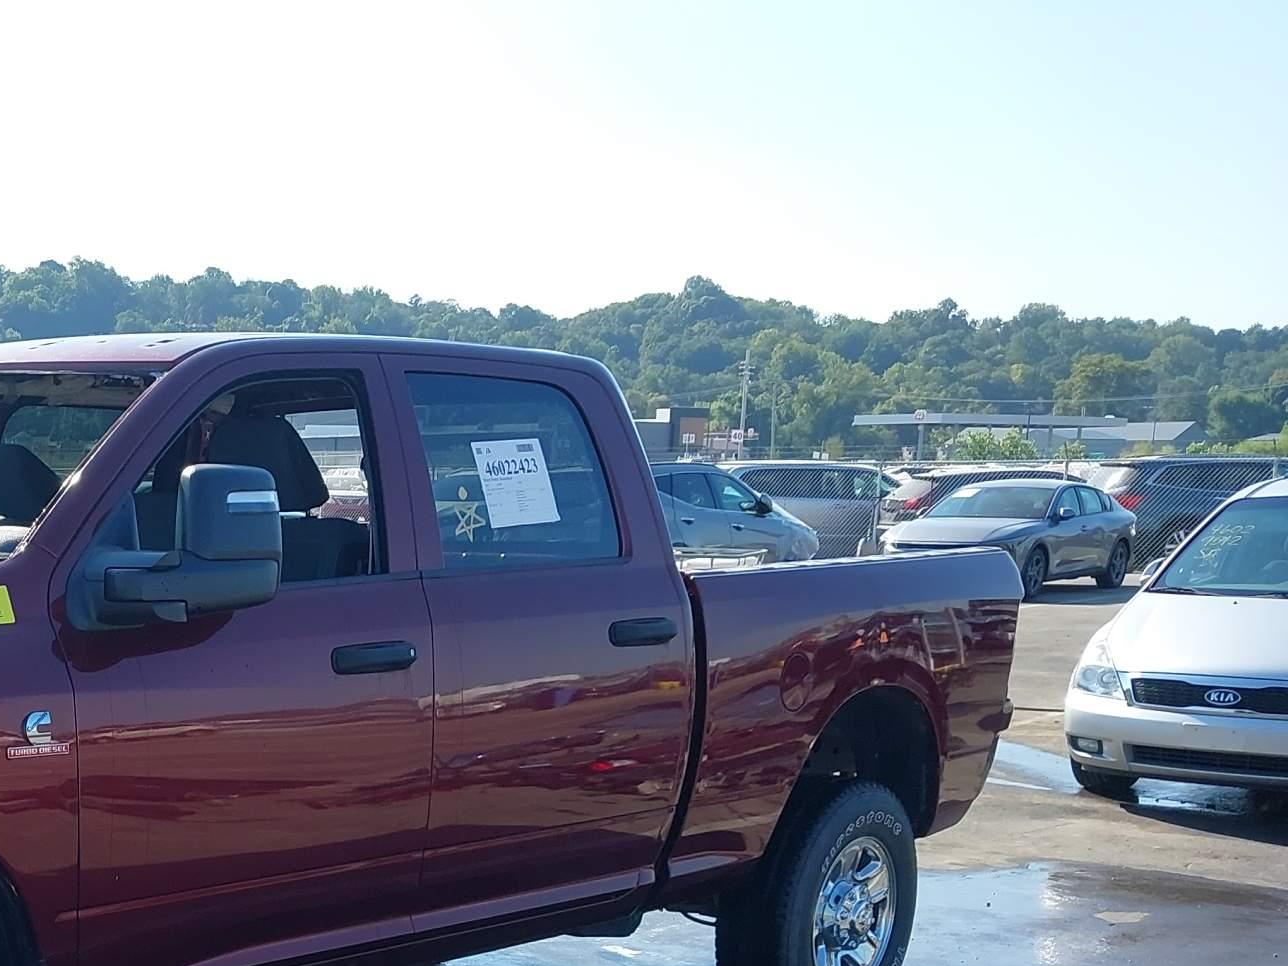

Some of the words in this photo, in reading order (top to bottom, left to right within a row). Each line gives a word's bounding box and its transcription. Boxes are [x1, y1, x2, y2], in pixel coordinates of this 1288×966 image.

[732, 432, 742, 440] 40
[484, 457, 539, 476] 46022423
[1210, 692, 1234, 701] KIA
[39, 746, 68, 754] DIESEL
